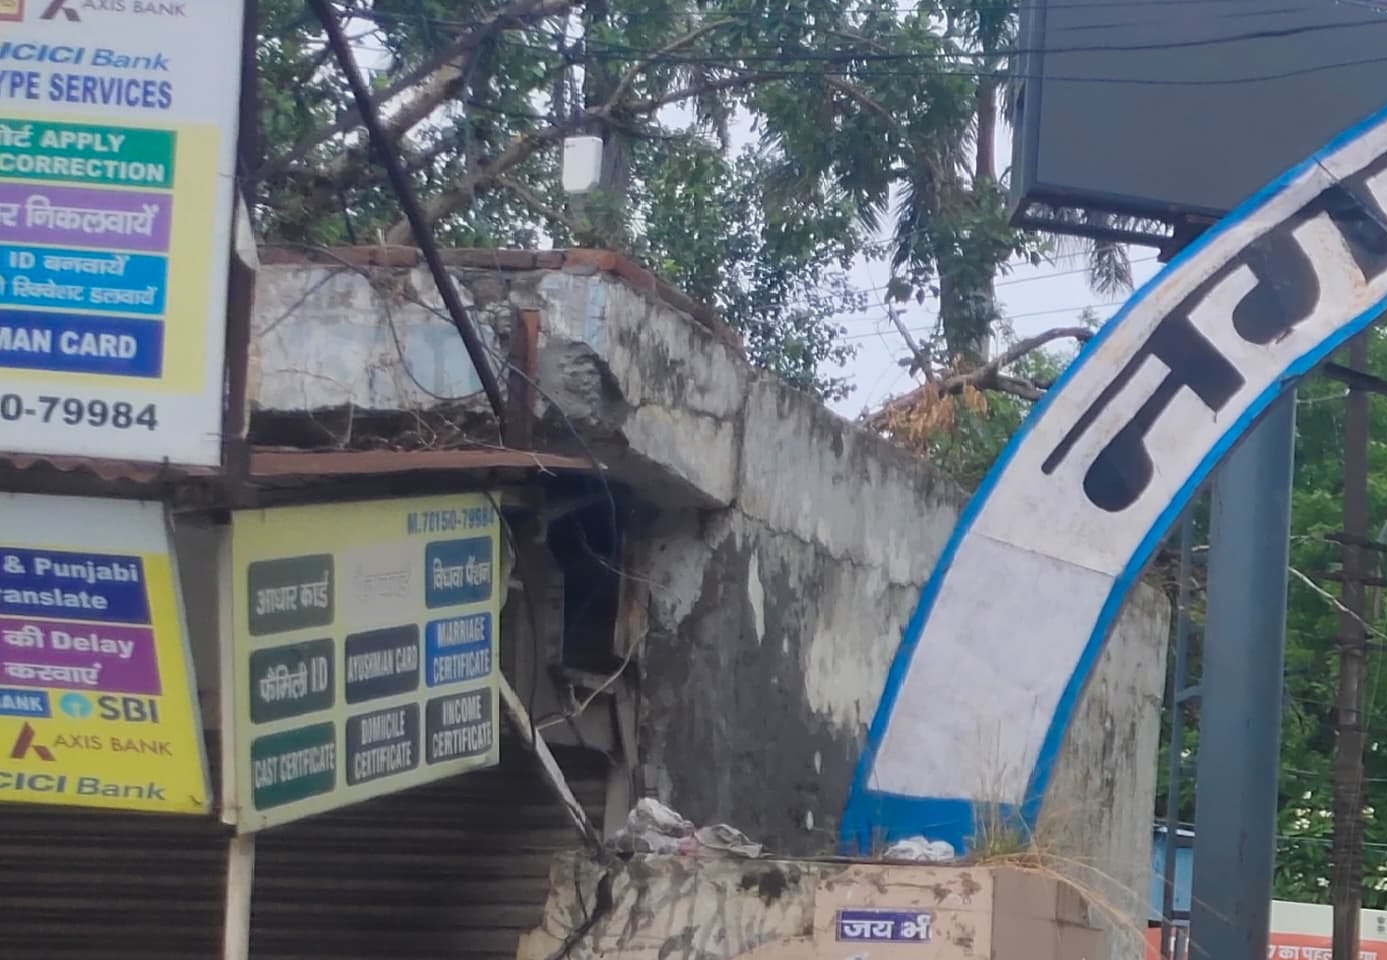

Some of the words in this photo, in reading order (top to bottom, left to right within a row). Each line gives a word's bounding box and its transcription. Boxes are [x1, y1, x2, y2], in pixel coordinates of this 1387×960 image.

[133, 1, 187, 17] BANK
[91, 48, 170, 71] Bank
[49, 73, 173, 109] SERVICES
[40, 130, 125, 152] APPLY
[0, 153, 164, 182] CORRECTION
[9, 251, 35, 269] ID
[60, 332, 137, 359] CARD
[0, 393, 158, 431] 0-79984
[3, 556, 25, 575] &
[33, 557, 139, 584] Punjabi
[256, 584, 297, 615] आधार
[52, 631, 134, 660] Delay
[437, 616, 485, 648] MARRIAGE
[395, 645, 418, 673] CARD
[433, 648, 490, 683] CERTIFICATE
[0, 694, 43, 712] ANK
[98, 696, 159, 723] SBI
[442, 695, 482, 725] INCOME
[361, 710, 405, 745] DOMICILE
[433, 721, 491, 758] CERTIFICATE
[53, 734, 103, 752] AXIS
[111, 737, 173, 755] BANK
[254, 757, 278, 788] CAST
[280, 743, 335, 780] CERTIFICATE
[76, 777, 166, 800] Bank
[842, 920, 894, 938] जय
